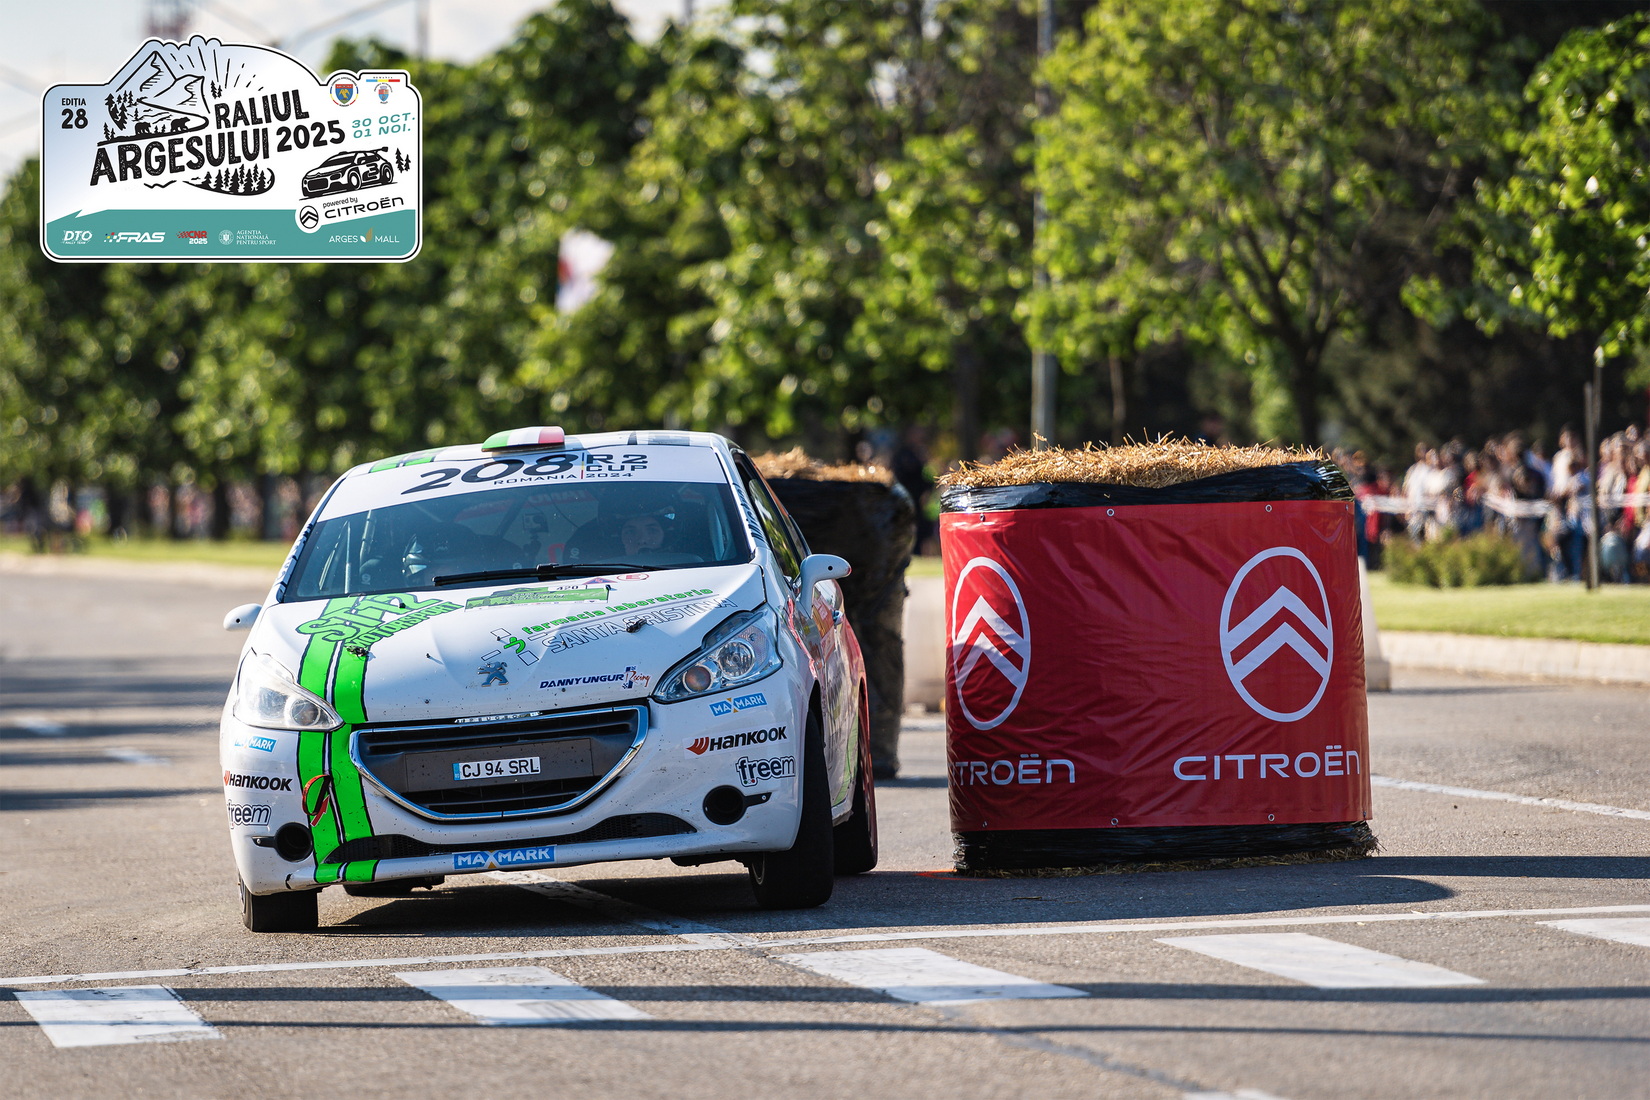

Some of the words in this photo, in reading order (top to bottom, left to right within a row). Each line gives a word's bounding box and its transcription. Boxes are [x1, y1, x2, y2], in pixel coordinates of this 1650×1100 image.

[401, 453, 579, 495] 208
[493, 473, 576, 486] ROMANIA
[586, 464, 648, 472] CUP
[586, 472, 634, 480] 2024
[521, 609, 605, 634] farmacia
[605, 587, 714, 613] laboratorio
[344, 601, 464, 650] MOTORSPORT
[542, 621, 626, 654] SANTA
[462, 763, 481, 778] CJ
[484, 761, 504, 776] 94
[508, 758, 540, 774] SRL
[738, 757, 795, 784] freem
[457, 848, 551, 868] MAXMARK
